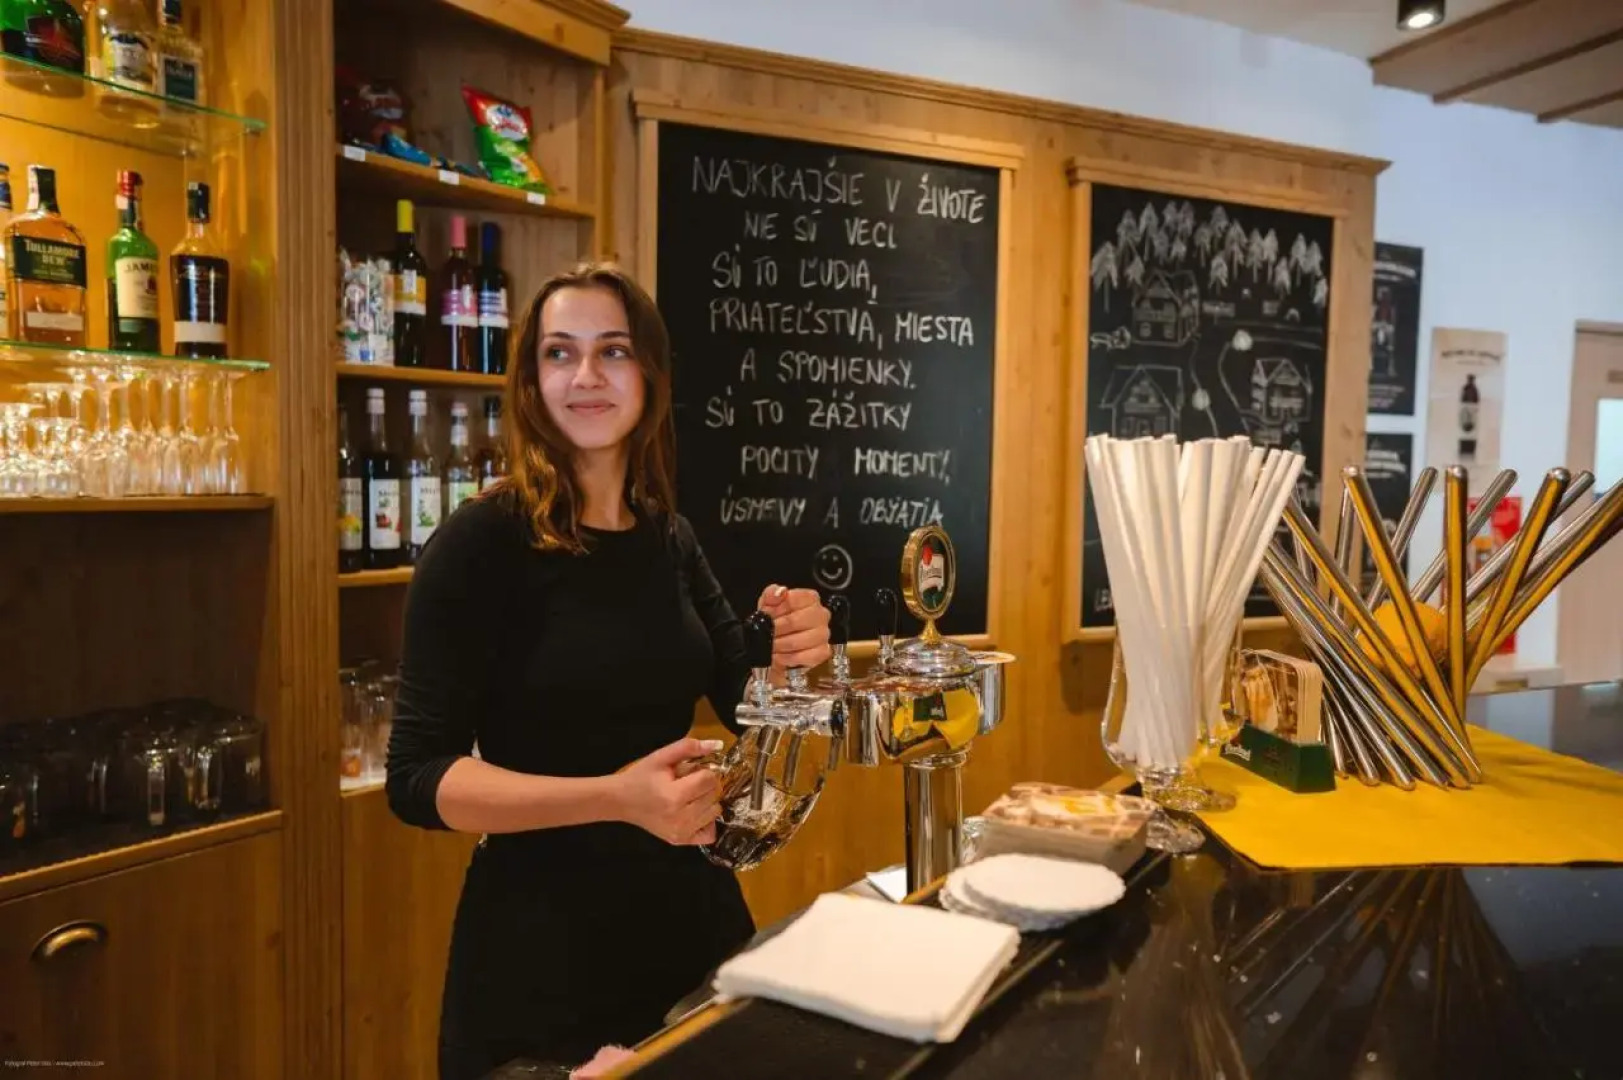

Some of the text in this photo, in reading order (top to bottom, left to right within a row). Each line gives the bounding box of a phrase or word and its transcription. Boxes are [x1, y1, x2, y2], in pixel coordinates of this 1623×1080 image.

[692, 154, 864, 205] NAJKRAJŠIE
[886, 178, 901, 213] V
[744, 211, 779, 240] NE
[753, 255, 778, 286] TO
[895, 311, 974, 346] MIESTA
[740, 349, 755, 381] A
[752, 398, 784, 427] TO
[740, 445, 819, 479] POCITY
[823, 497, 839, 529] A
